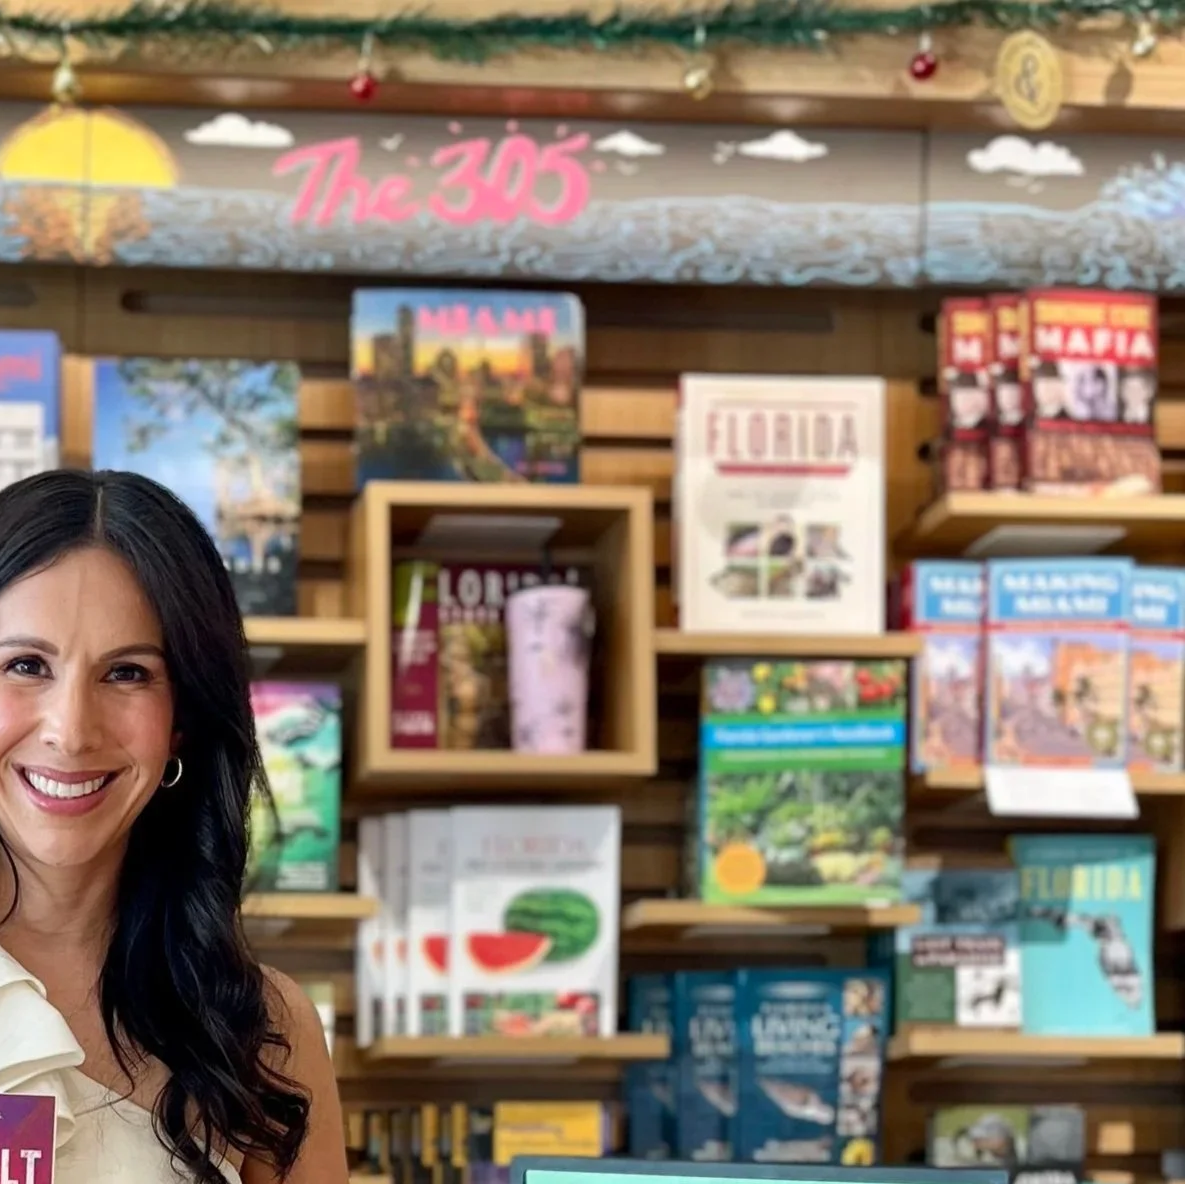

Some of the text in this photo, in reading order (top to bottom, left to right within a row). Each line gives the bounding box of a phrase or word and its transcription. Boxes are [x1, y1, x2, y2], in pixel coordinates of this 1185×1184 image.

[272, 132, 591, 227] The 305
[1034, 326, 1155, 358] MAFIA
[706, 411, 858, 460] FLORIDA
[1019, 864, 1142, 900] FLORIDA
